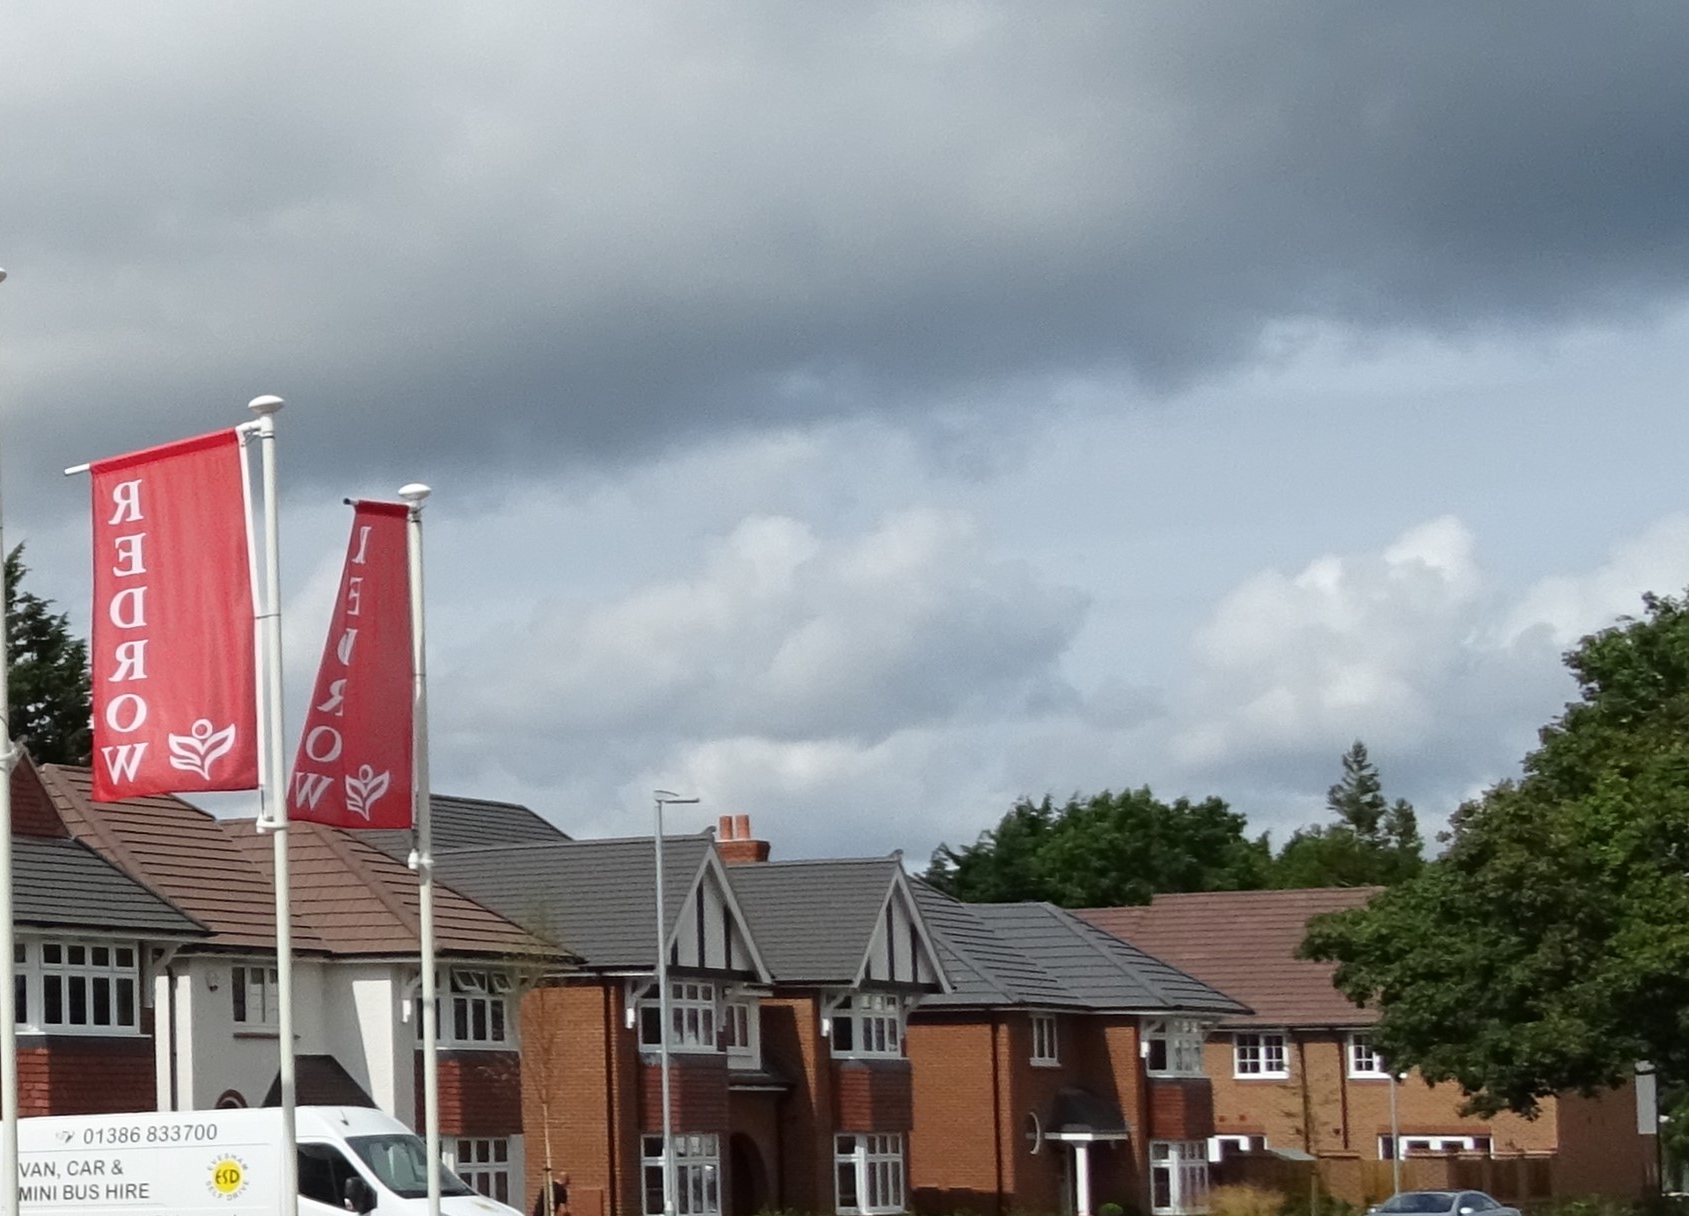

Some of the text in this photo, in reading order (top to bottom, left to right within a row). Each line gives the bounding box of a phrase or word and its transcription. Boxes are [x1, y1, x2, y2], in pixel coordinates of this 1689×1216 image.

[83, 1123, 218, 1145] 01386 833700
[19, 1159, 124, 1179] VAN, CAR &
[215, 1168, 241, 1185] ESD
[18, 1183, 151, 1201] MINI BUS HIRE
